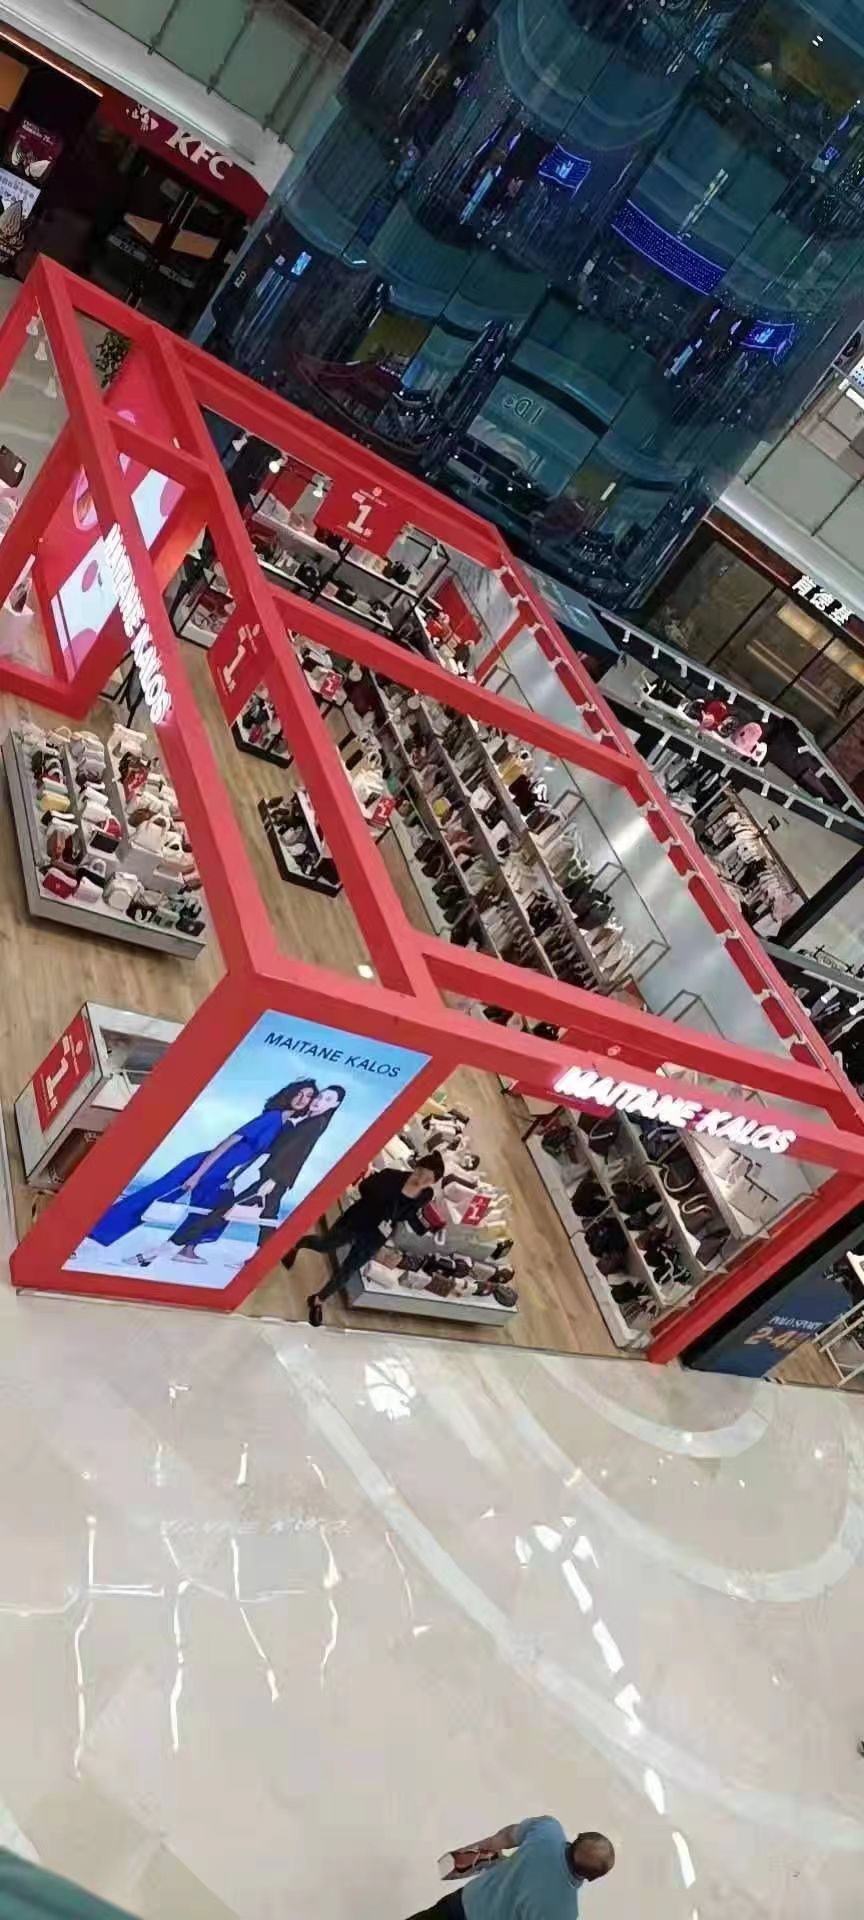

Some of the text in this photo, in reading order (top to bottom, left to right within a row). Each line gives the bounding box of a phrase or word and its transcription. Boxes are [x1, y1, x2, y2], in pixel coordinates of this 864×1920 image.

[164, 128, 235, 180] KFC
[791, 575, 856, 626] 肯德基
[131, 623, 172, 725] KALOS
[264, 1032, 401, 1078] MAITANE KALOS
[553, 1065, 797, 1154] MAITANE KALOS
